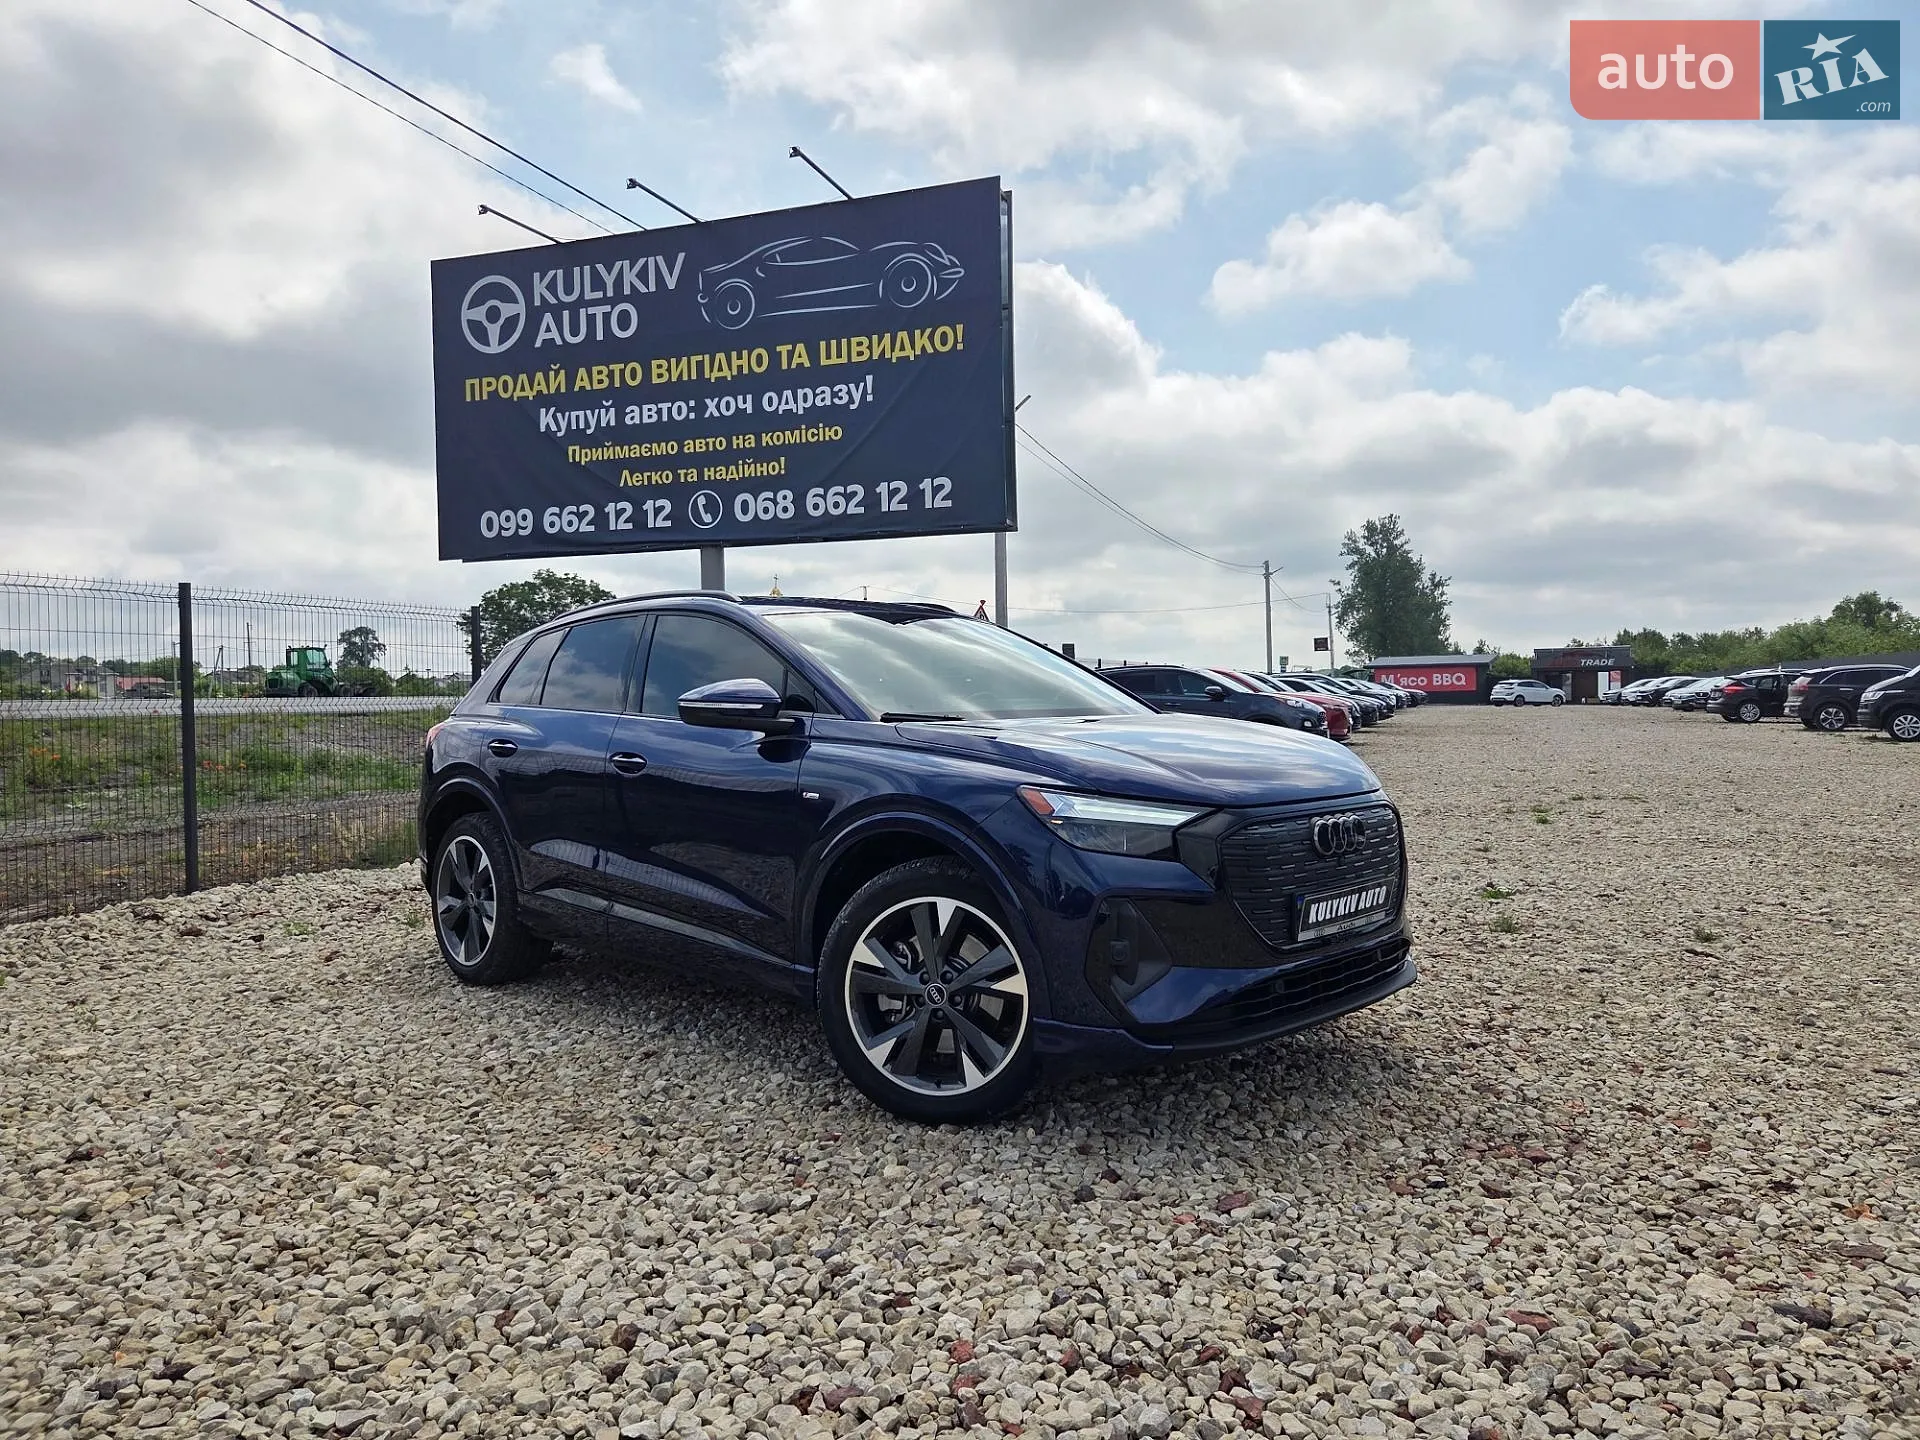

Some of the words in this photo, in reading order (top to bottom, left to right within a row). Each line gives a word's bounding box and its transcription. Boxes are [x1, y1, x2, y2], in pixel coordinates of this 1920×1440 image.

[533, 252, 686, 306] KULYKIV
[534, 302, 639, 348] AUTO
[465, 363, 567, 401] ПРОДАЙ
[573, 361, 642, 391] АВТО
[651, 347, 769, 384] ВИГІДНО
[776, 343, 810, 370] ТА
[819, 324, 964, 366] ШВИДКО!
[539, 400, 616, 437] Купуй
[624, 400, 696, 425] авто:
[704, 394, 753, 418] хоч
[762, 375, 874, 414] одразу!
[568, 441, 678, 465] Приймаємо
[683, 436, 727, 453] авто
[732, 434, 756, 449] на
[762, 423, 843, 447] комісію
[619, 469, 673, 488] Легко
[678, 469, 698, 483] та
[704, 457, 785, 482] надійно!
[480, 508, 533, 539] 099
[543, 504, 595, 534] 662
[604, 501, 633, 531] 12
[642, 499, 672, 528] 12
[734, 490, 795, 522] 068
[806, 484, 865, 517] 662
[875, 480, 908, 512] 12
[919, 476, 952, 509] 12
[1432, 672, 1466, 686] BBQ
[1580, 658, 1615, 667] TRADE
[1308, 893, 1358, 924] KULYKIV
[1358, 886, 1387, 910] AUTO
